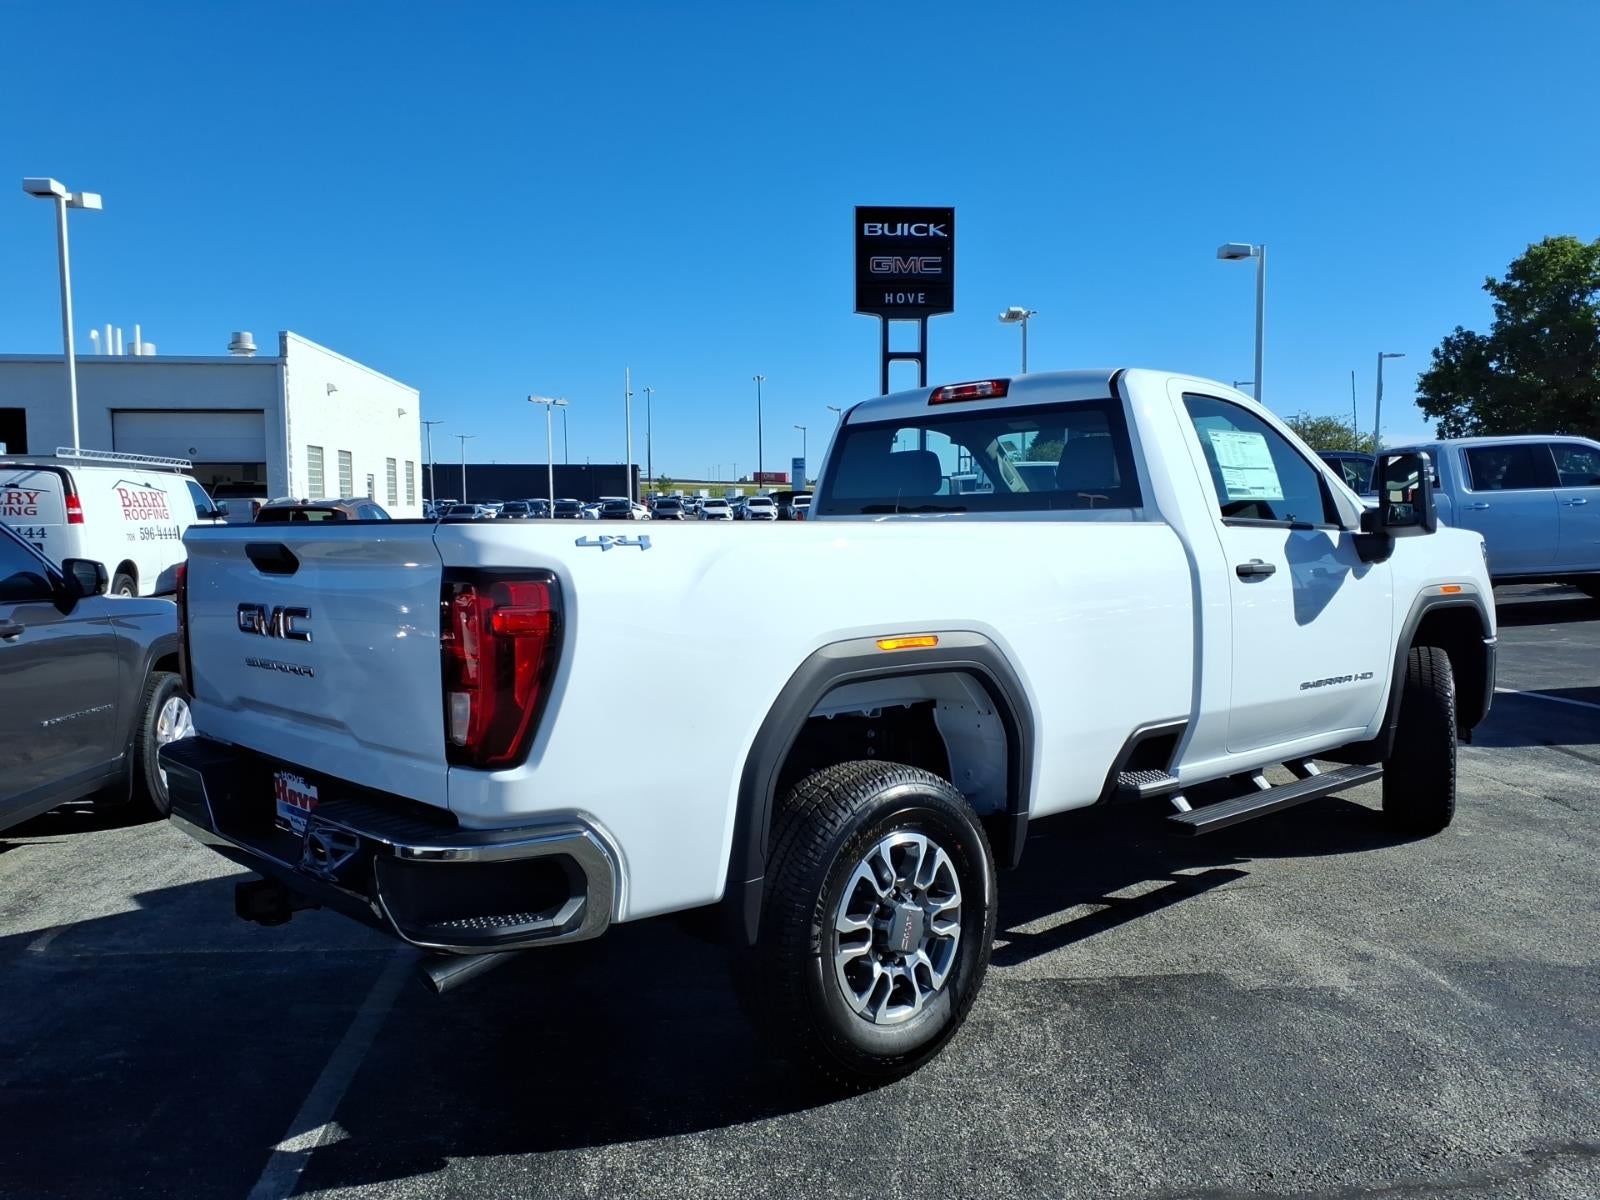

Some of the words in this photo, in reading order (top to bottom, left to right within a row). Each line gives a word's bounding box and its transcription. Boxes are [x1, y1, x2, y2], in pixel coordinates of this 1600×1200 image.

[863, 222, 948, 237] BUICK
[869, 256, 942, 274] GMC
[884, 292, 926, 304] HOVE
[0, 491, 40, 505] RY
[116, 488, 167, 508] BARRY
[0, 506, 38, 516] ING
[123, 508, 170, 521] ROOFING
[238, 602, 313, 643] GMC
[245, 657, 315, 678] SIERRA
[1299, 674, 1353, 691] SIERRA
[1353, 671, 1374, 682] HD
